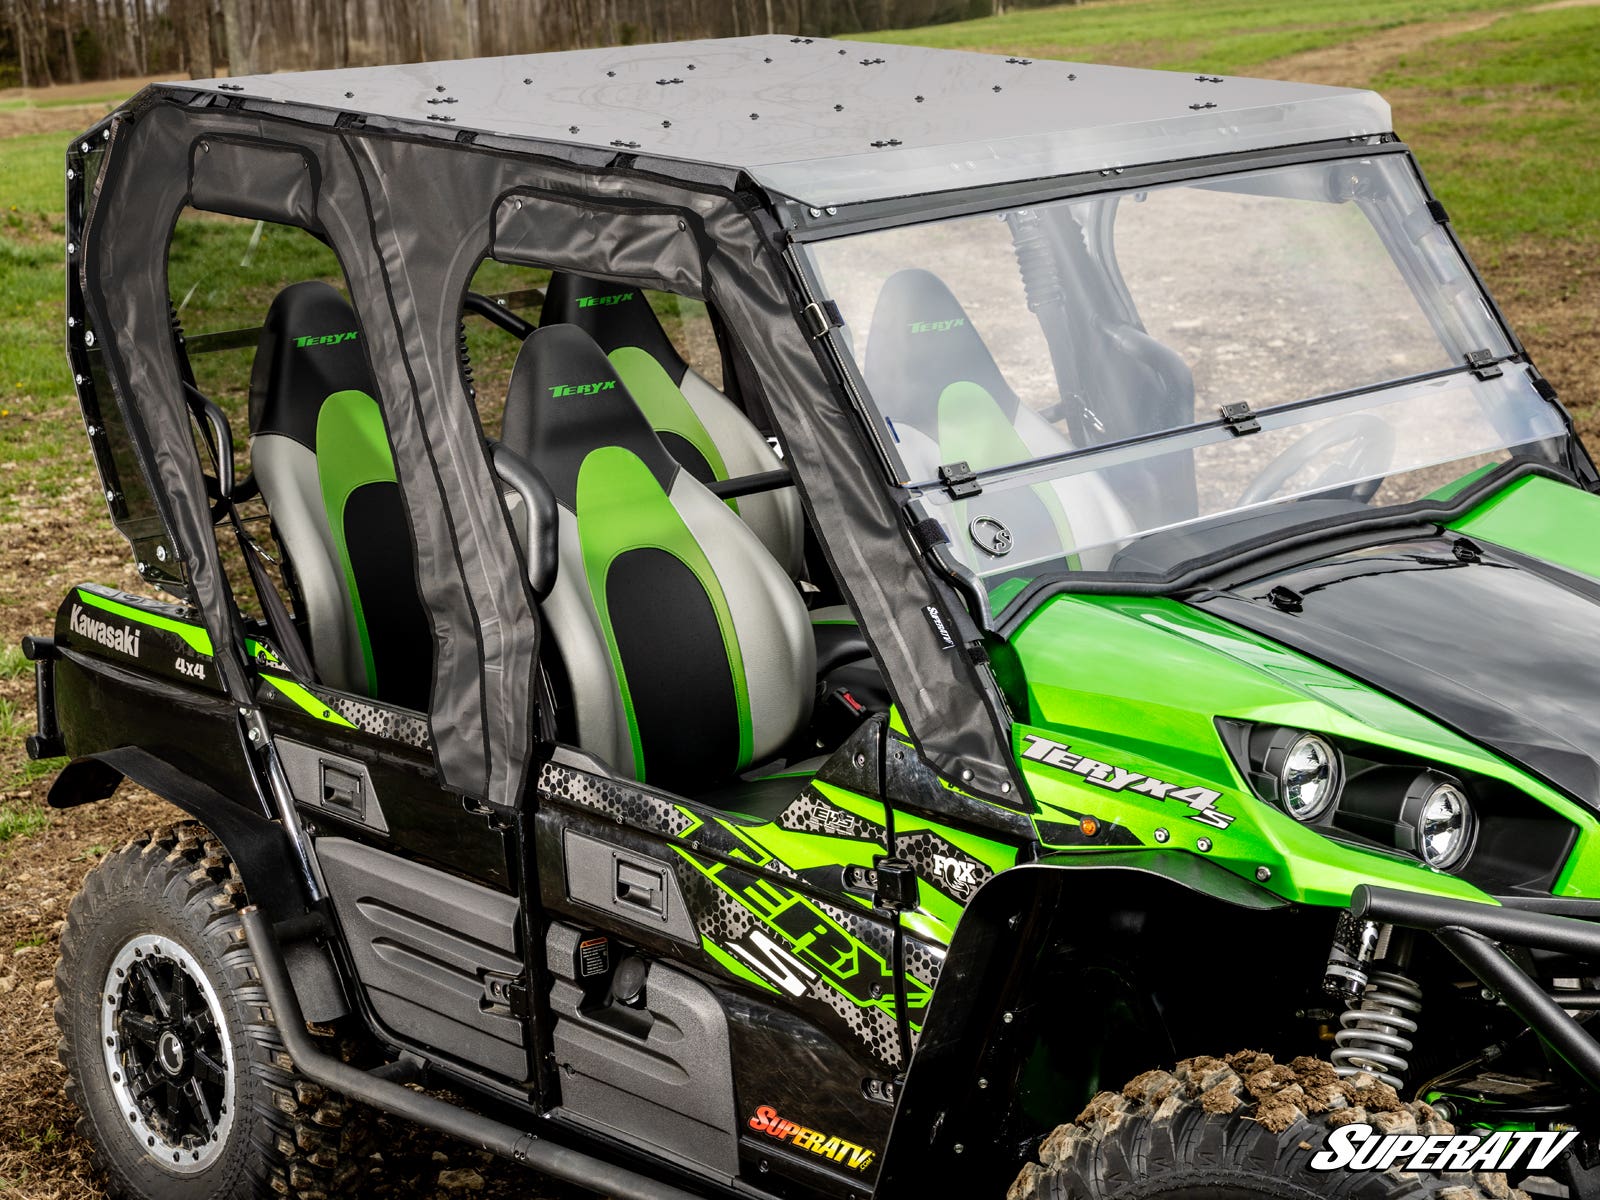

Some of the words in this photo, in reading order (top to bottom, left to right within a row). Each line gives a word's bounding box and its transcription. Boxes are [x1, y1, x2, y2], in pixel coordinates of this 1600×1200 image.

[575, 292, 633, 309] TERYX
[292, 331, 358, 348] TERYX
[548, 380, 616, 398] TERYX
[69, 603, 141, 658] Kawasaki
[174, 656, 206, 681] 4x4
[933, 853, 977, 895] FOX
[749, 1104, 873, 1170] SUPERATV
